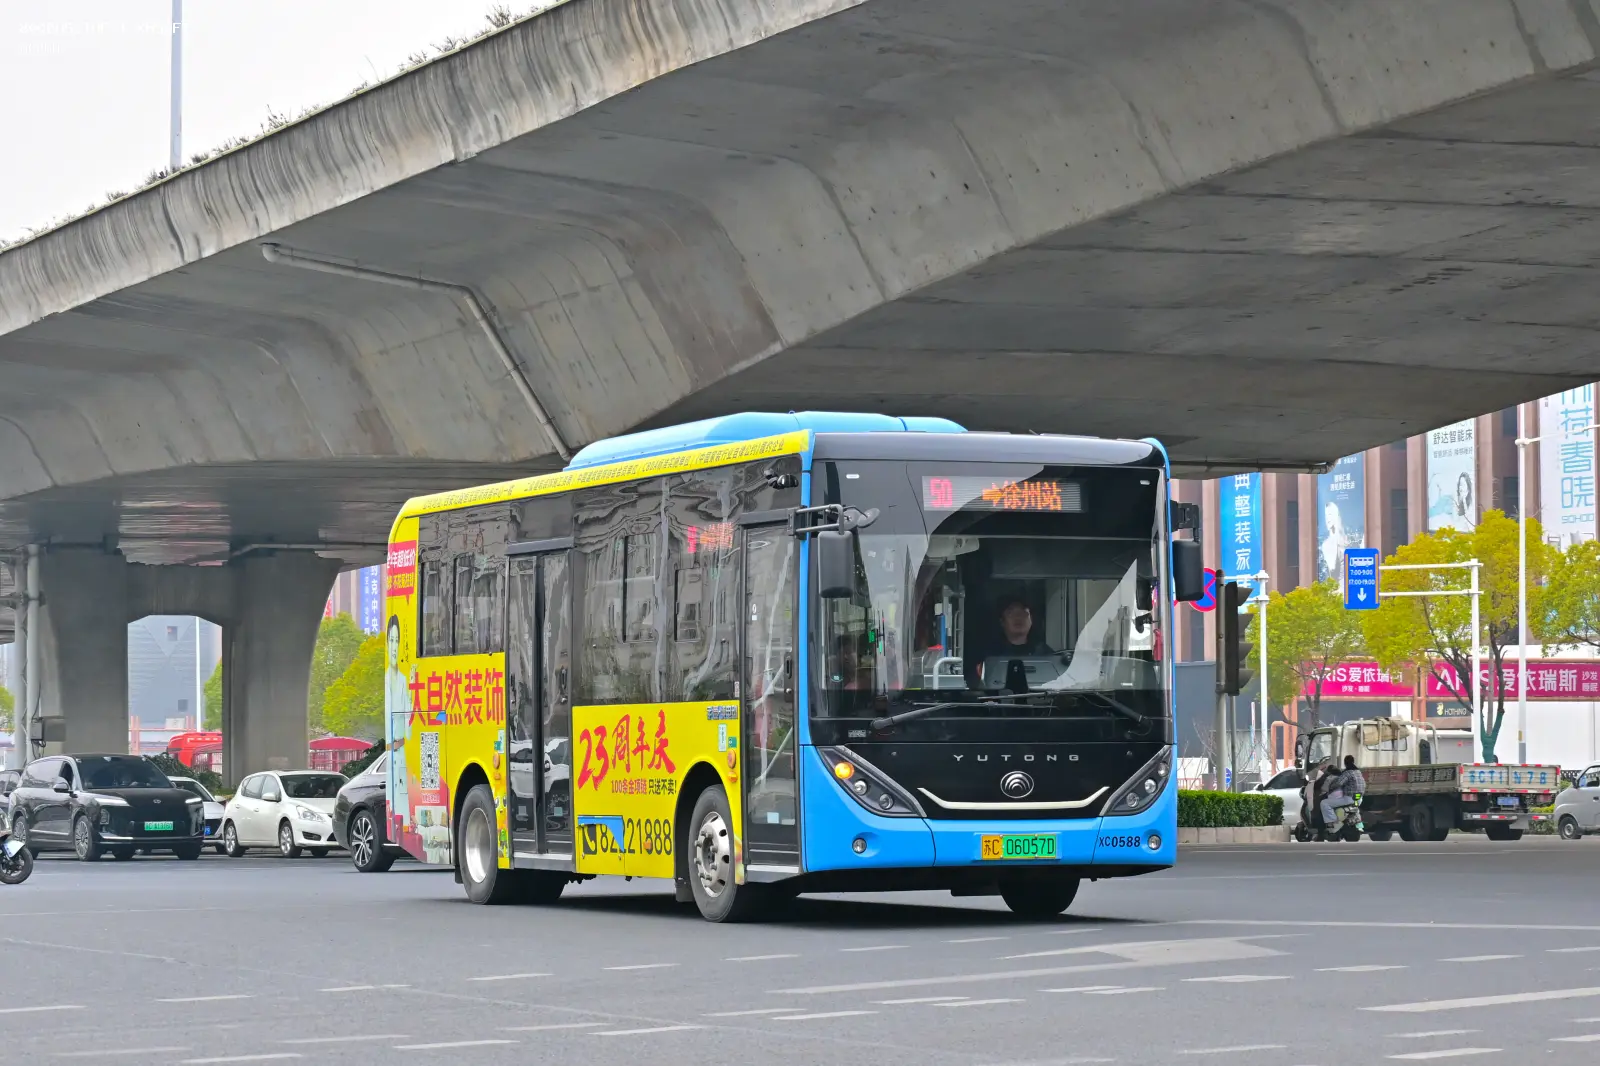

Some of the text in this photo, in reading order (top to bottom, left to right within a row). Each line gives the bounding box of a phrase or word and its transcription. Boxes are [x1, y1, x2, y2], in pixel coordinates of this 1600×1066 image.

[1433, 429, 1473, 445] 舒达智能床
[1001, 480, 1062, 510] 徐州站
[1582, 671, 1598, 681] 沙发
[409, 667, 505, 727] 大自然装饰
[953, 754, 1080, 762] YUTONG
[600, 817, 672, 855] 8221888
[1099, 836, 1141, 847] XC0588
[1006, 837, 1055, 855] 06057D
